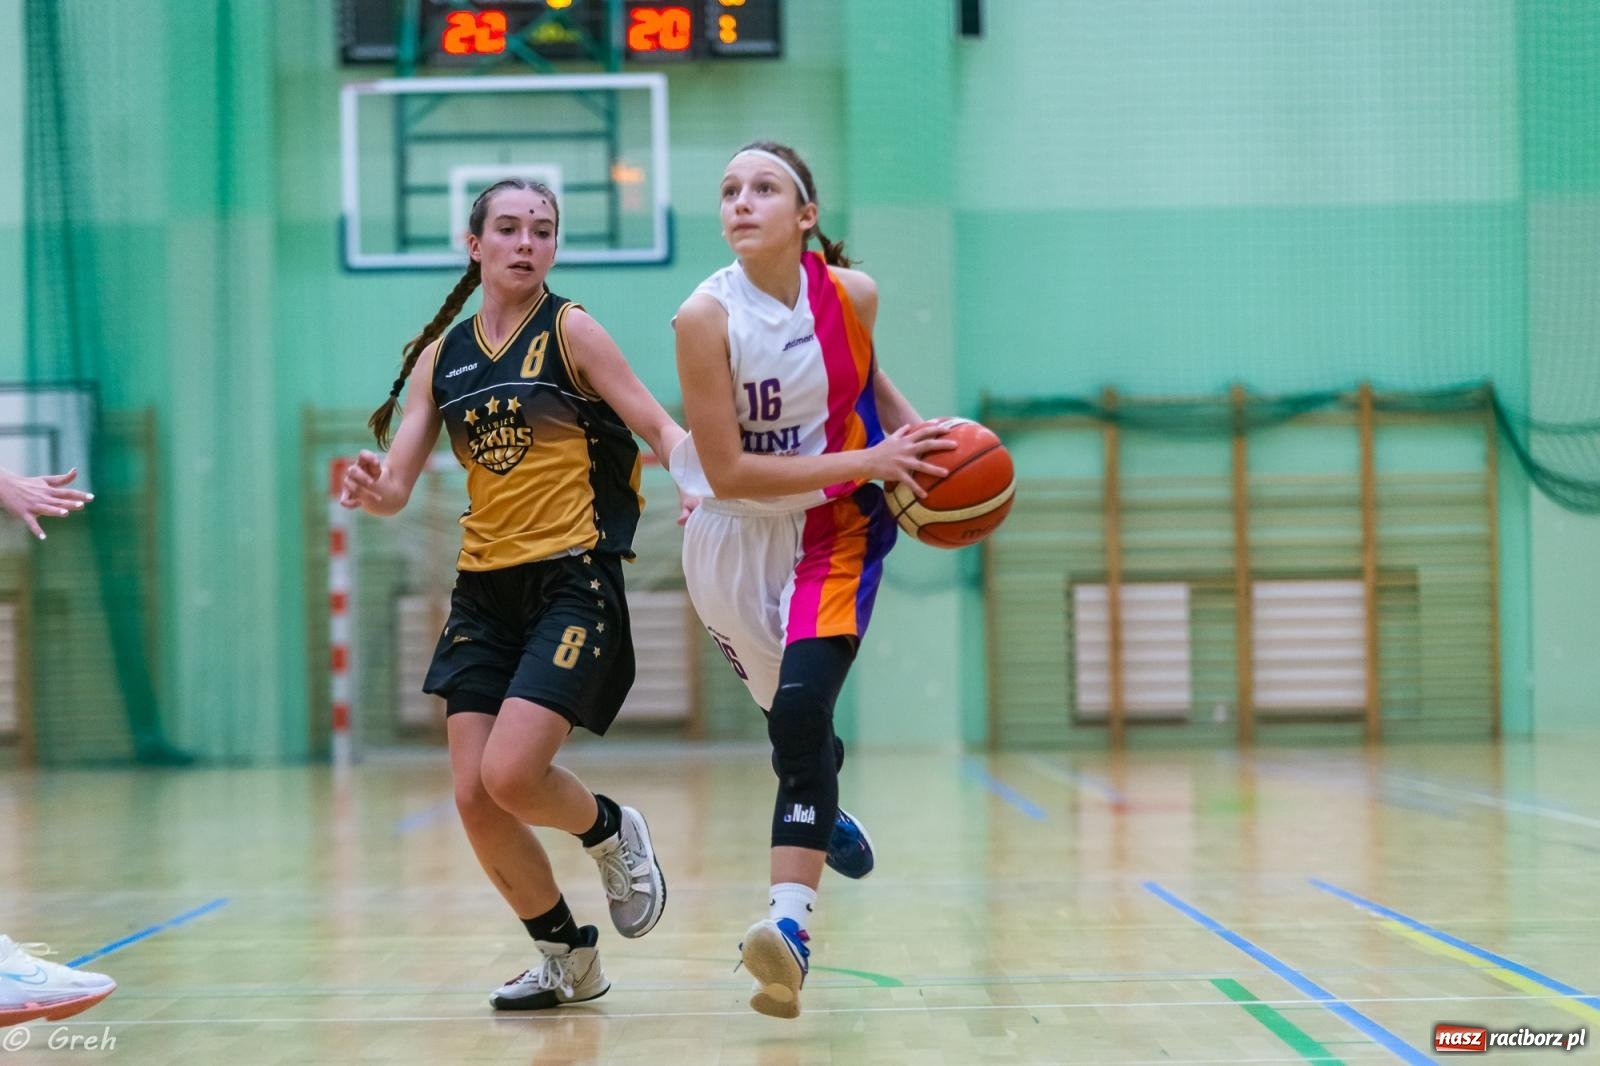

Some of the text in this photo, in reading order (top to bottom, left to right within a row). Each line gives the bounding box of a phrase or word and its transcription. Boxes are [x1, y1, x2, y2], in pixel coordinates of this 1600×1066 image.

[628, 6, 692, 51] 20
[520, 331, 550, 379] 8
[743, 378, 782, 421] 16
[468, 427, 531, 458] STARS
[553, 625, 587, 670] 8
[792, 803, 816, 825] NBA
